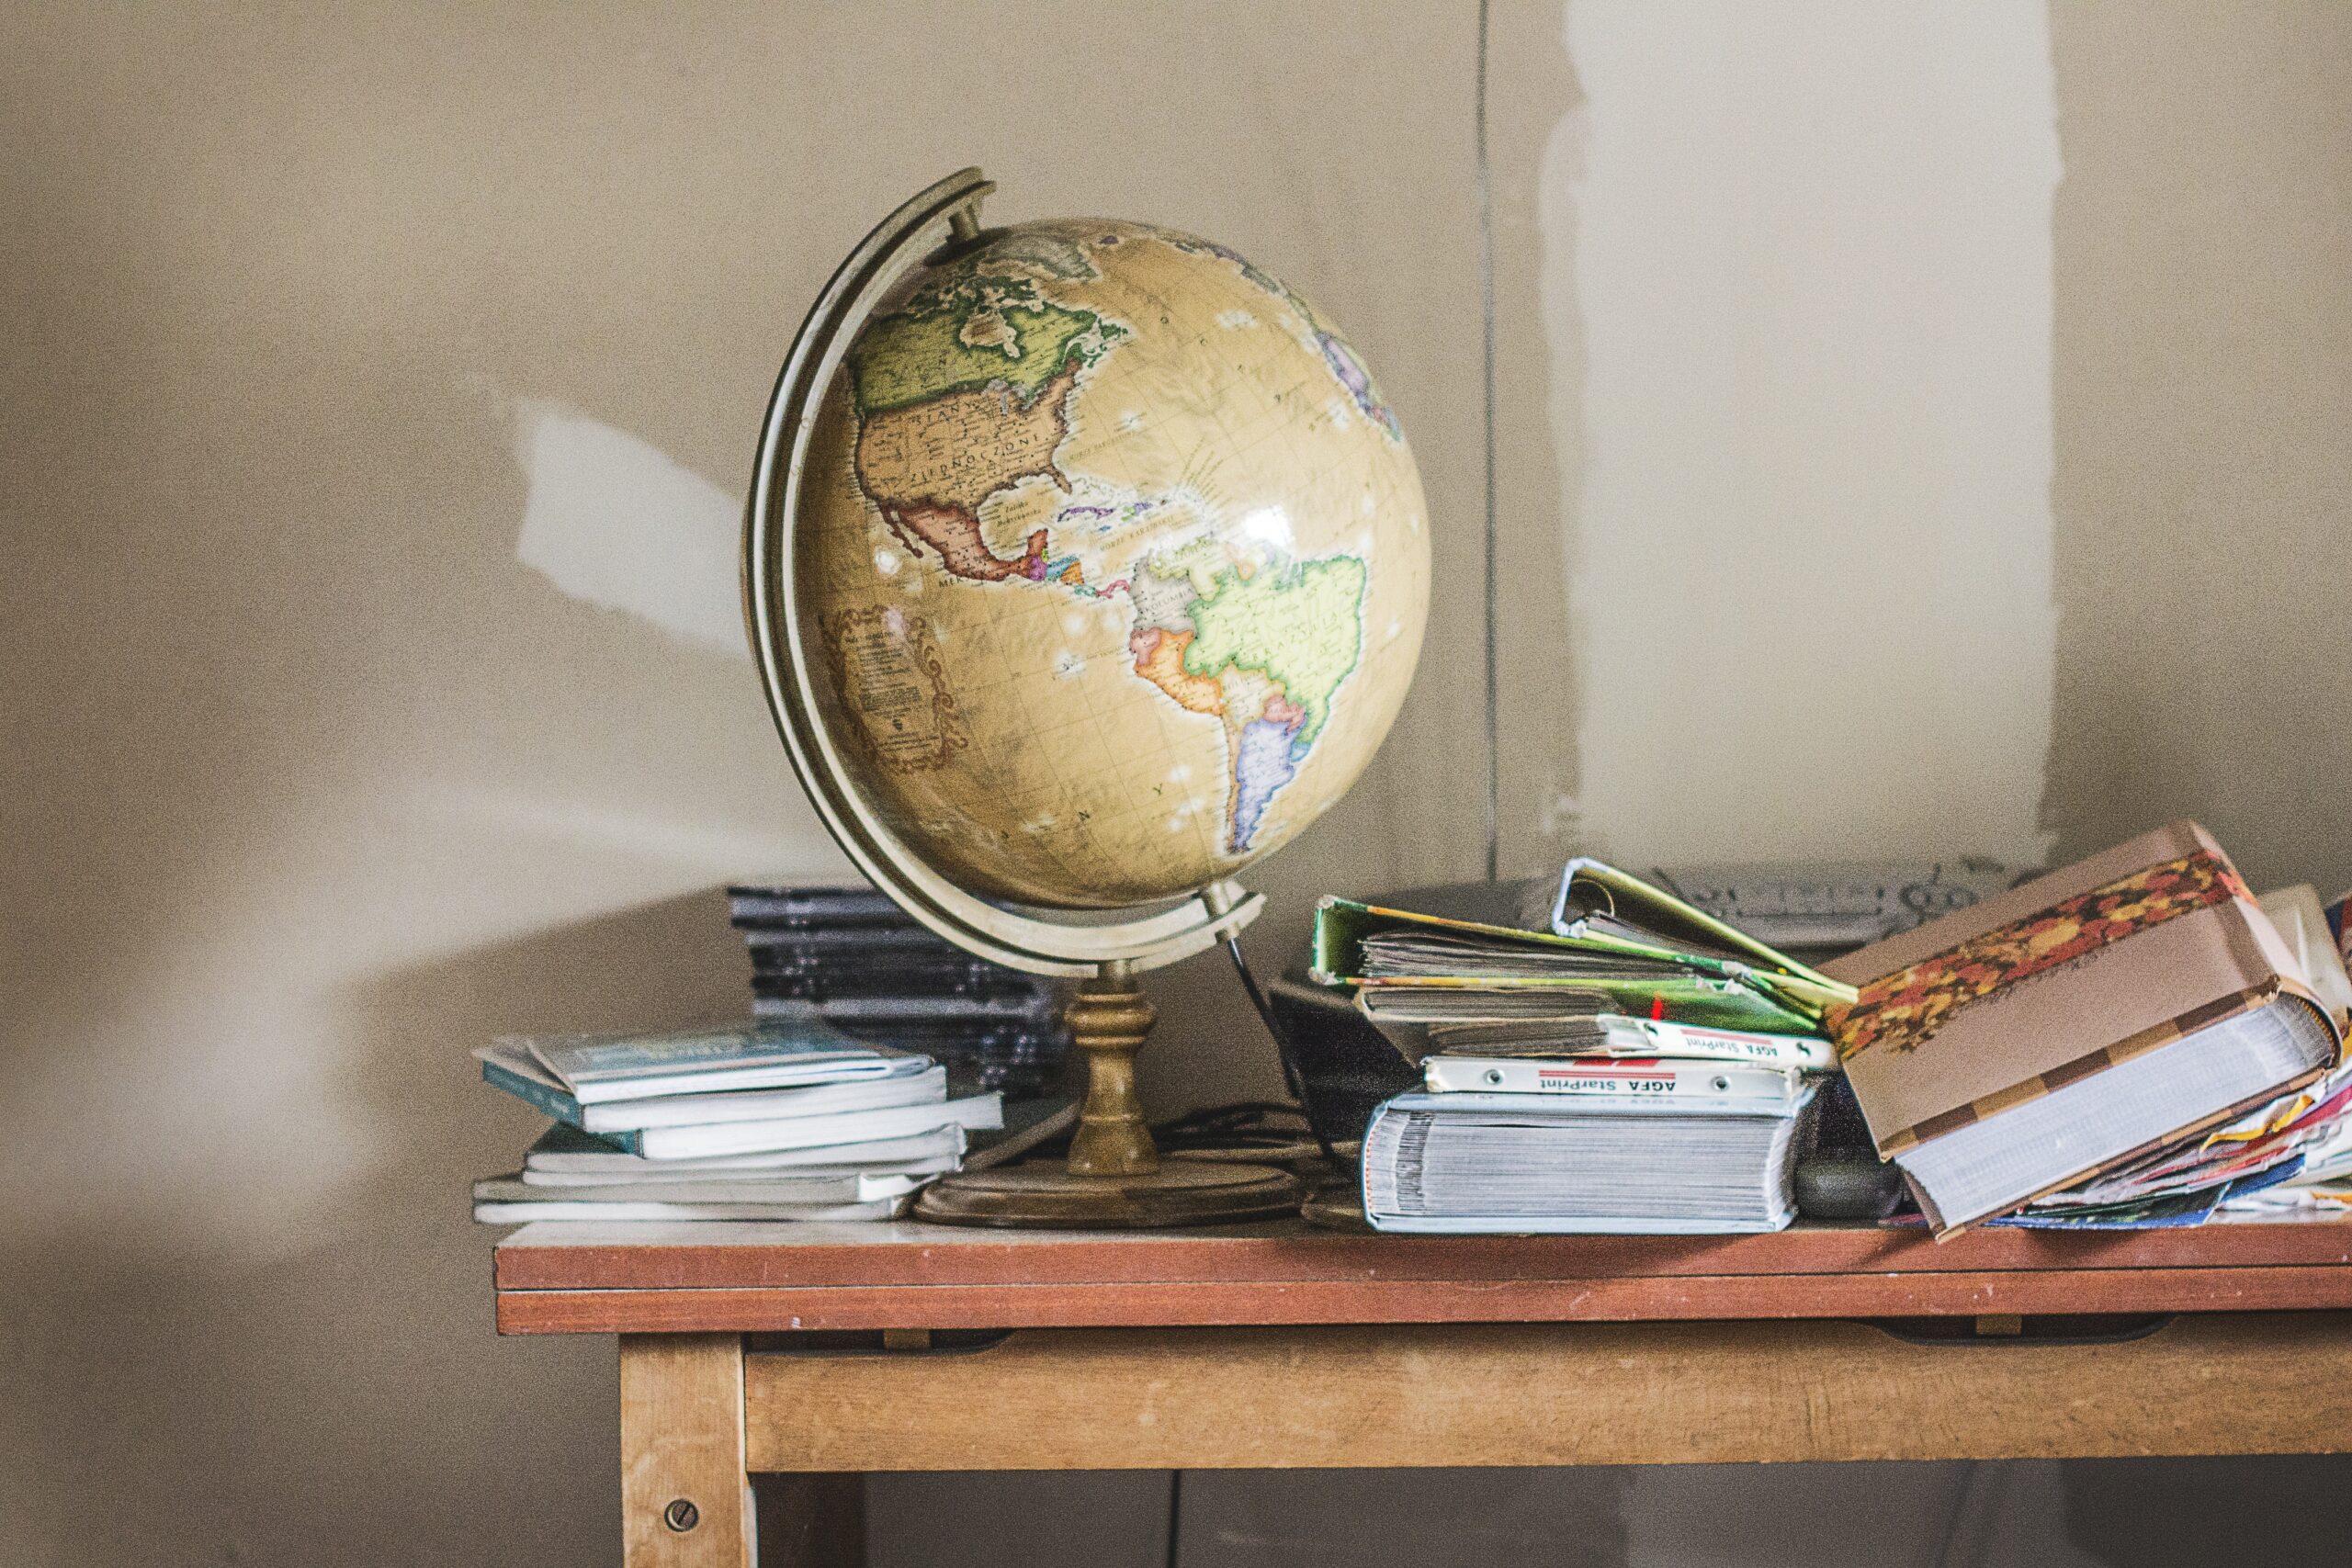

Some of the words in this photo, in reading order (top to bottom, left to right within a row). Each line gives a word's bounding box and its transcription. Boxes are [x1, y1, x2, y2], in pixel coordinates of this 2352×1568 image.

[1685, 1037, 1739, 1054] StarPrint
[1539, 1079, 1617, 1091] StarPrint
[1628, 1080, 1676, 1092] AGFA
